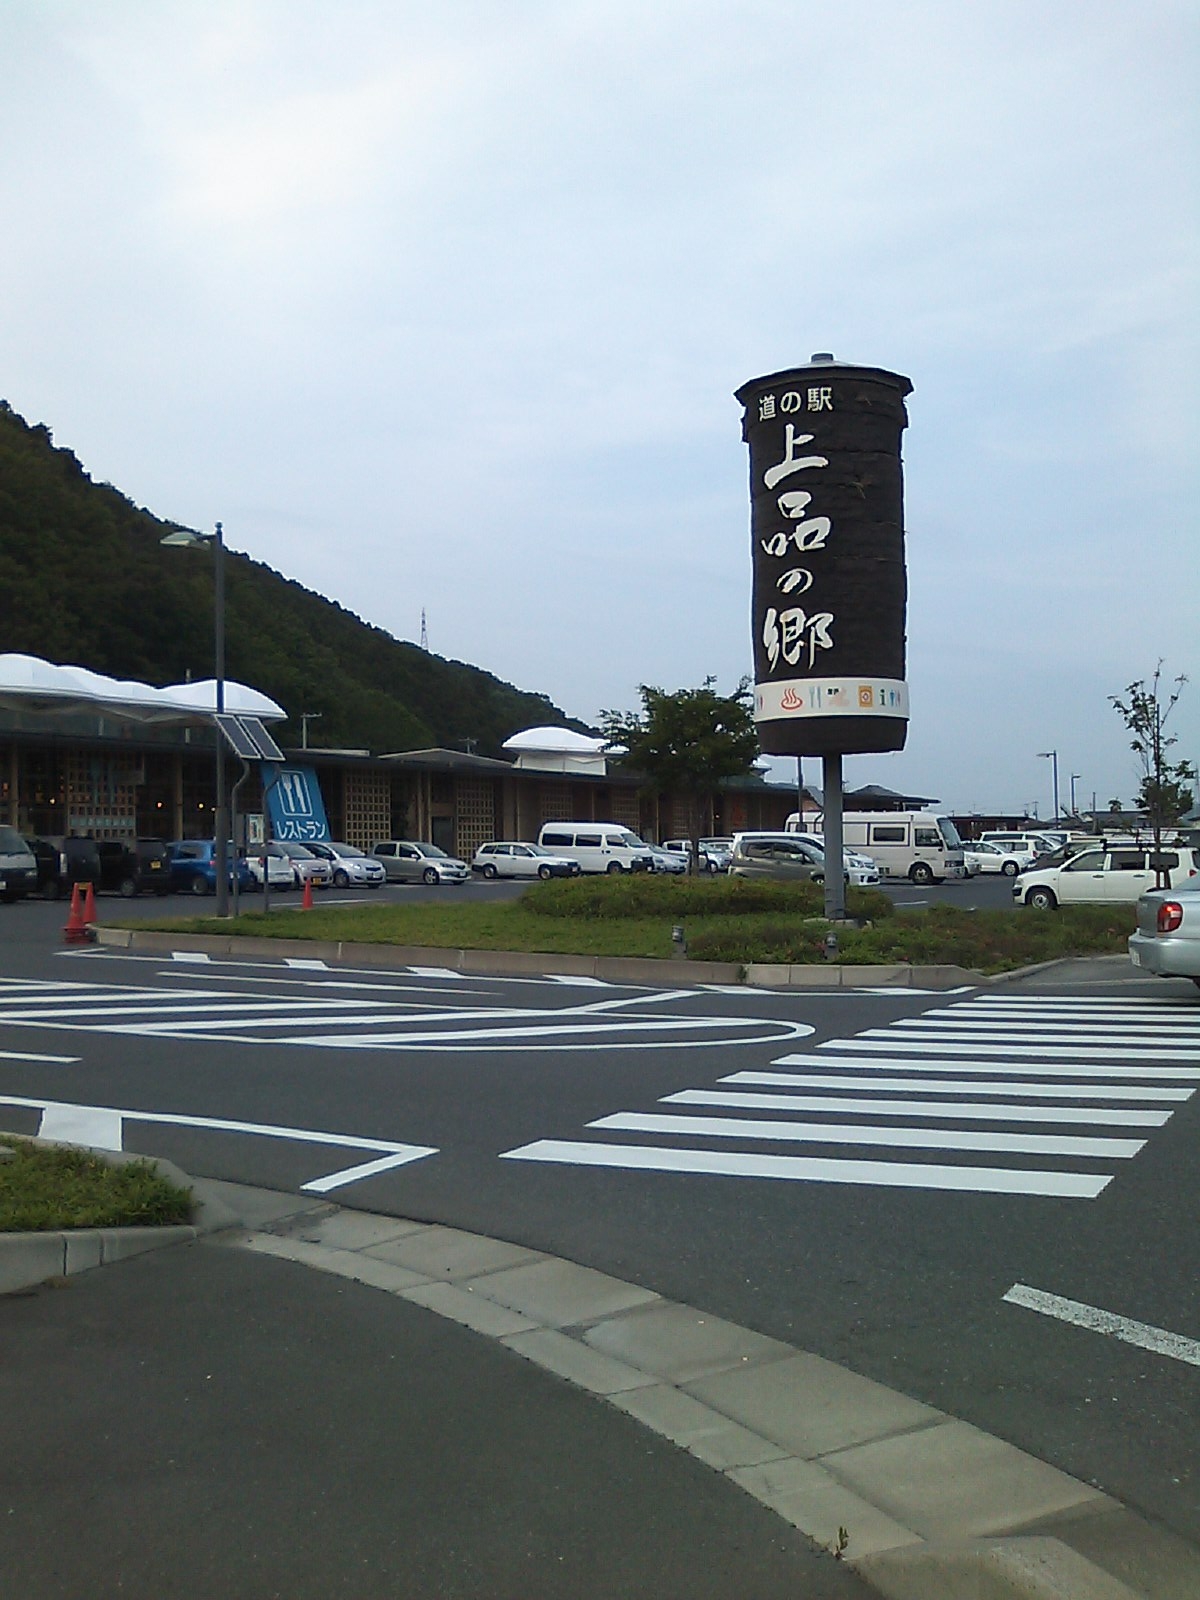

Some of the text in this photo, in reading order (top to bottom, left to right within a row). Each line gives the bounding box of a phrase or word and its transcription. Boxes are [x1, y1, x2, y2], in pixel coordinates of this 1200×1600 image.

[758, 386, 833, 421] 道の駅
[761, 423, 834, 673] 上品の郷
[276, 820, 326, 840] レストラン
